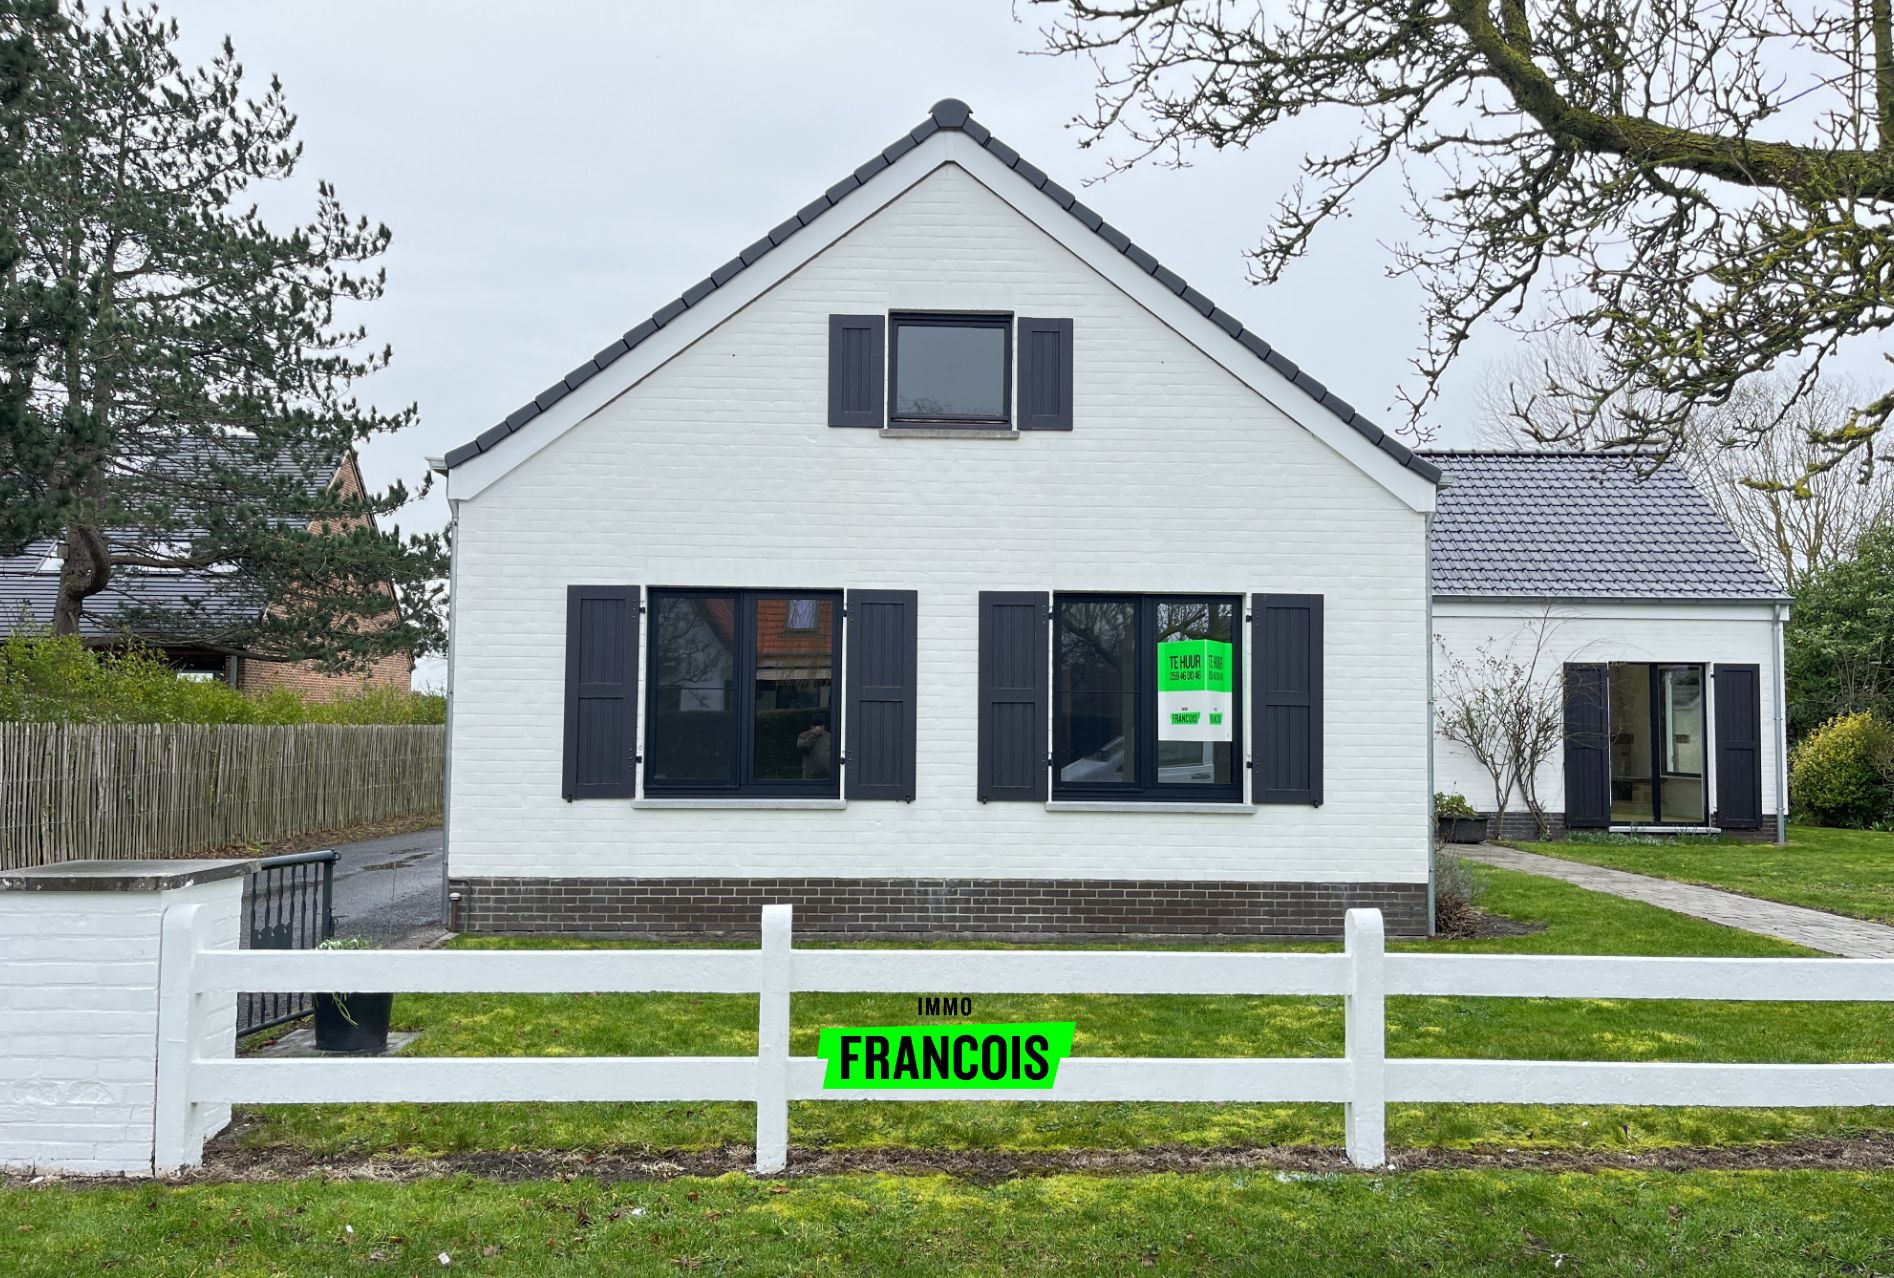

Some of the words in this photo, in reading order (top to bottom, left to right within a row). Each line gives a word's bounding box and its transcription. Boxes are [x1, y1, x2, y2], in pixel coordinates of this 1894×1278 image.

[1169, 655, 1179, 669] TE
[1180, 654, 1201, 669] HUUR
[1171, 713, 1198, 723] FRANCOIS
